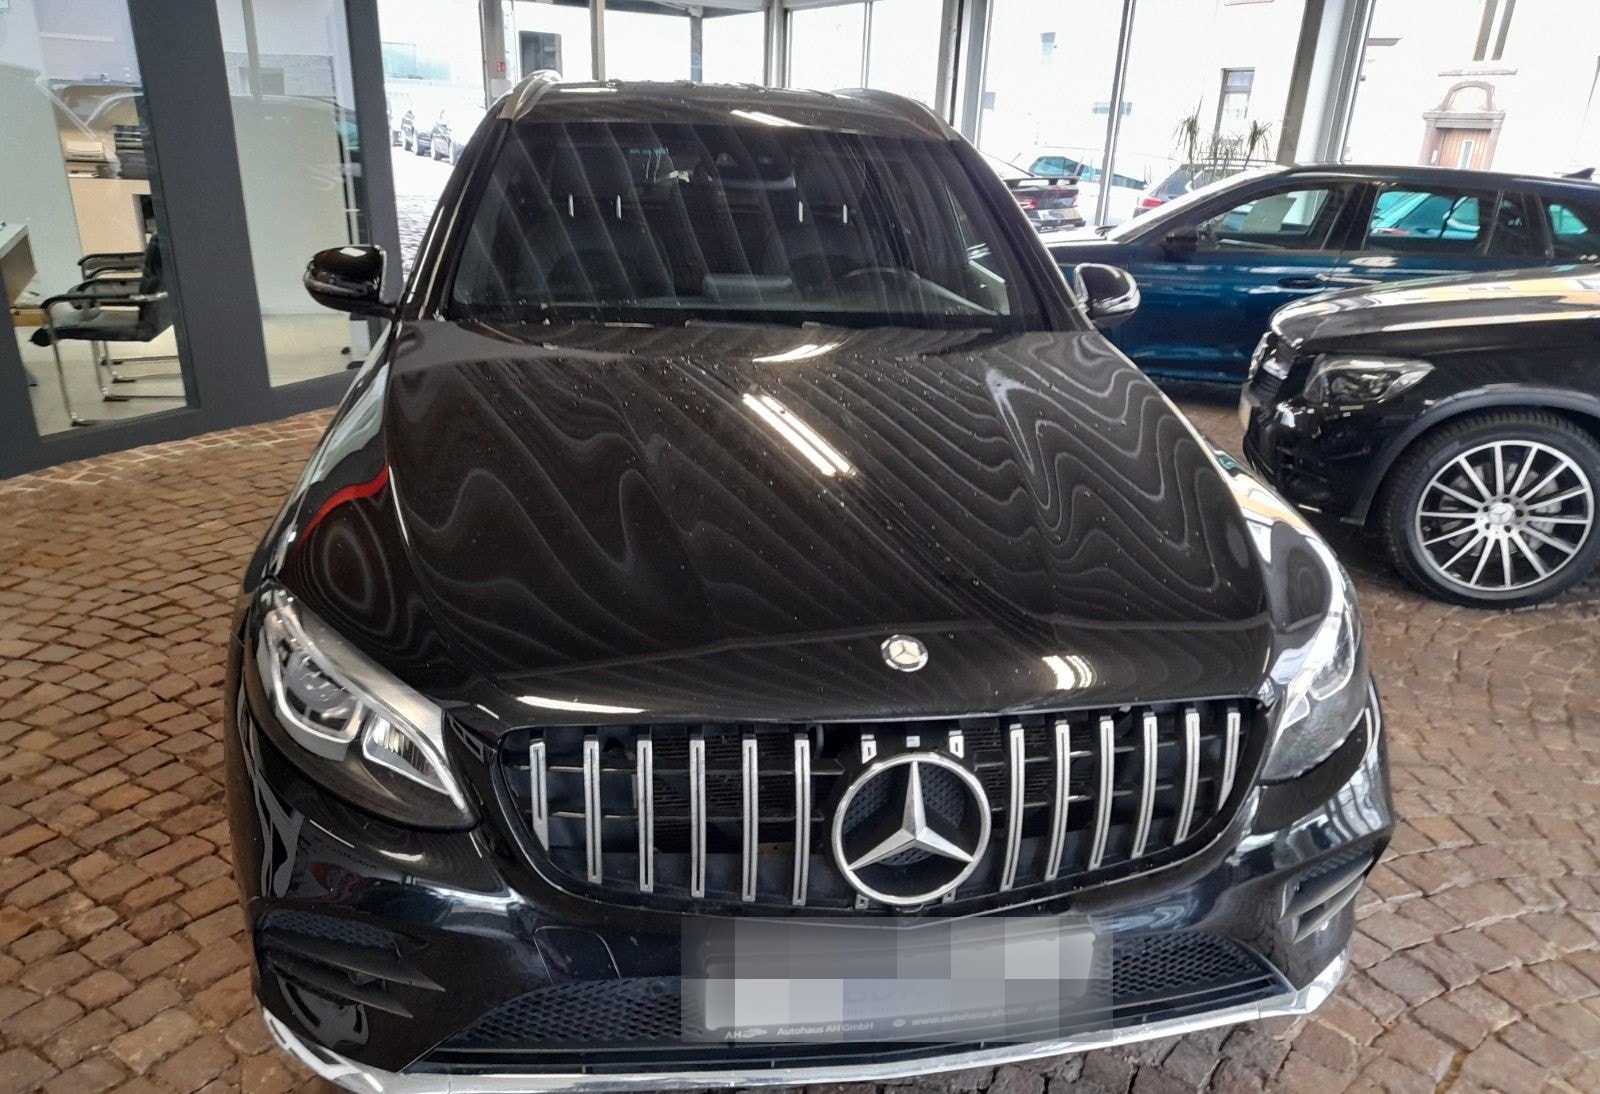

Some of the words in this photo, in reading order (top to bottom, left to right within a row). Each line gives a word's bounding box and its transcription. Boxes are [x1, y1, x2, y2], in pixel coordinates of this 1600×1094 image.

[776, 1026, 823, 1036] Autohaus
[825, 1024, 841, 1033] AH
[842, 1022, 874, 1032] GmbH
